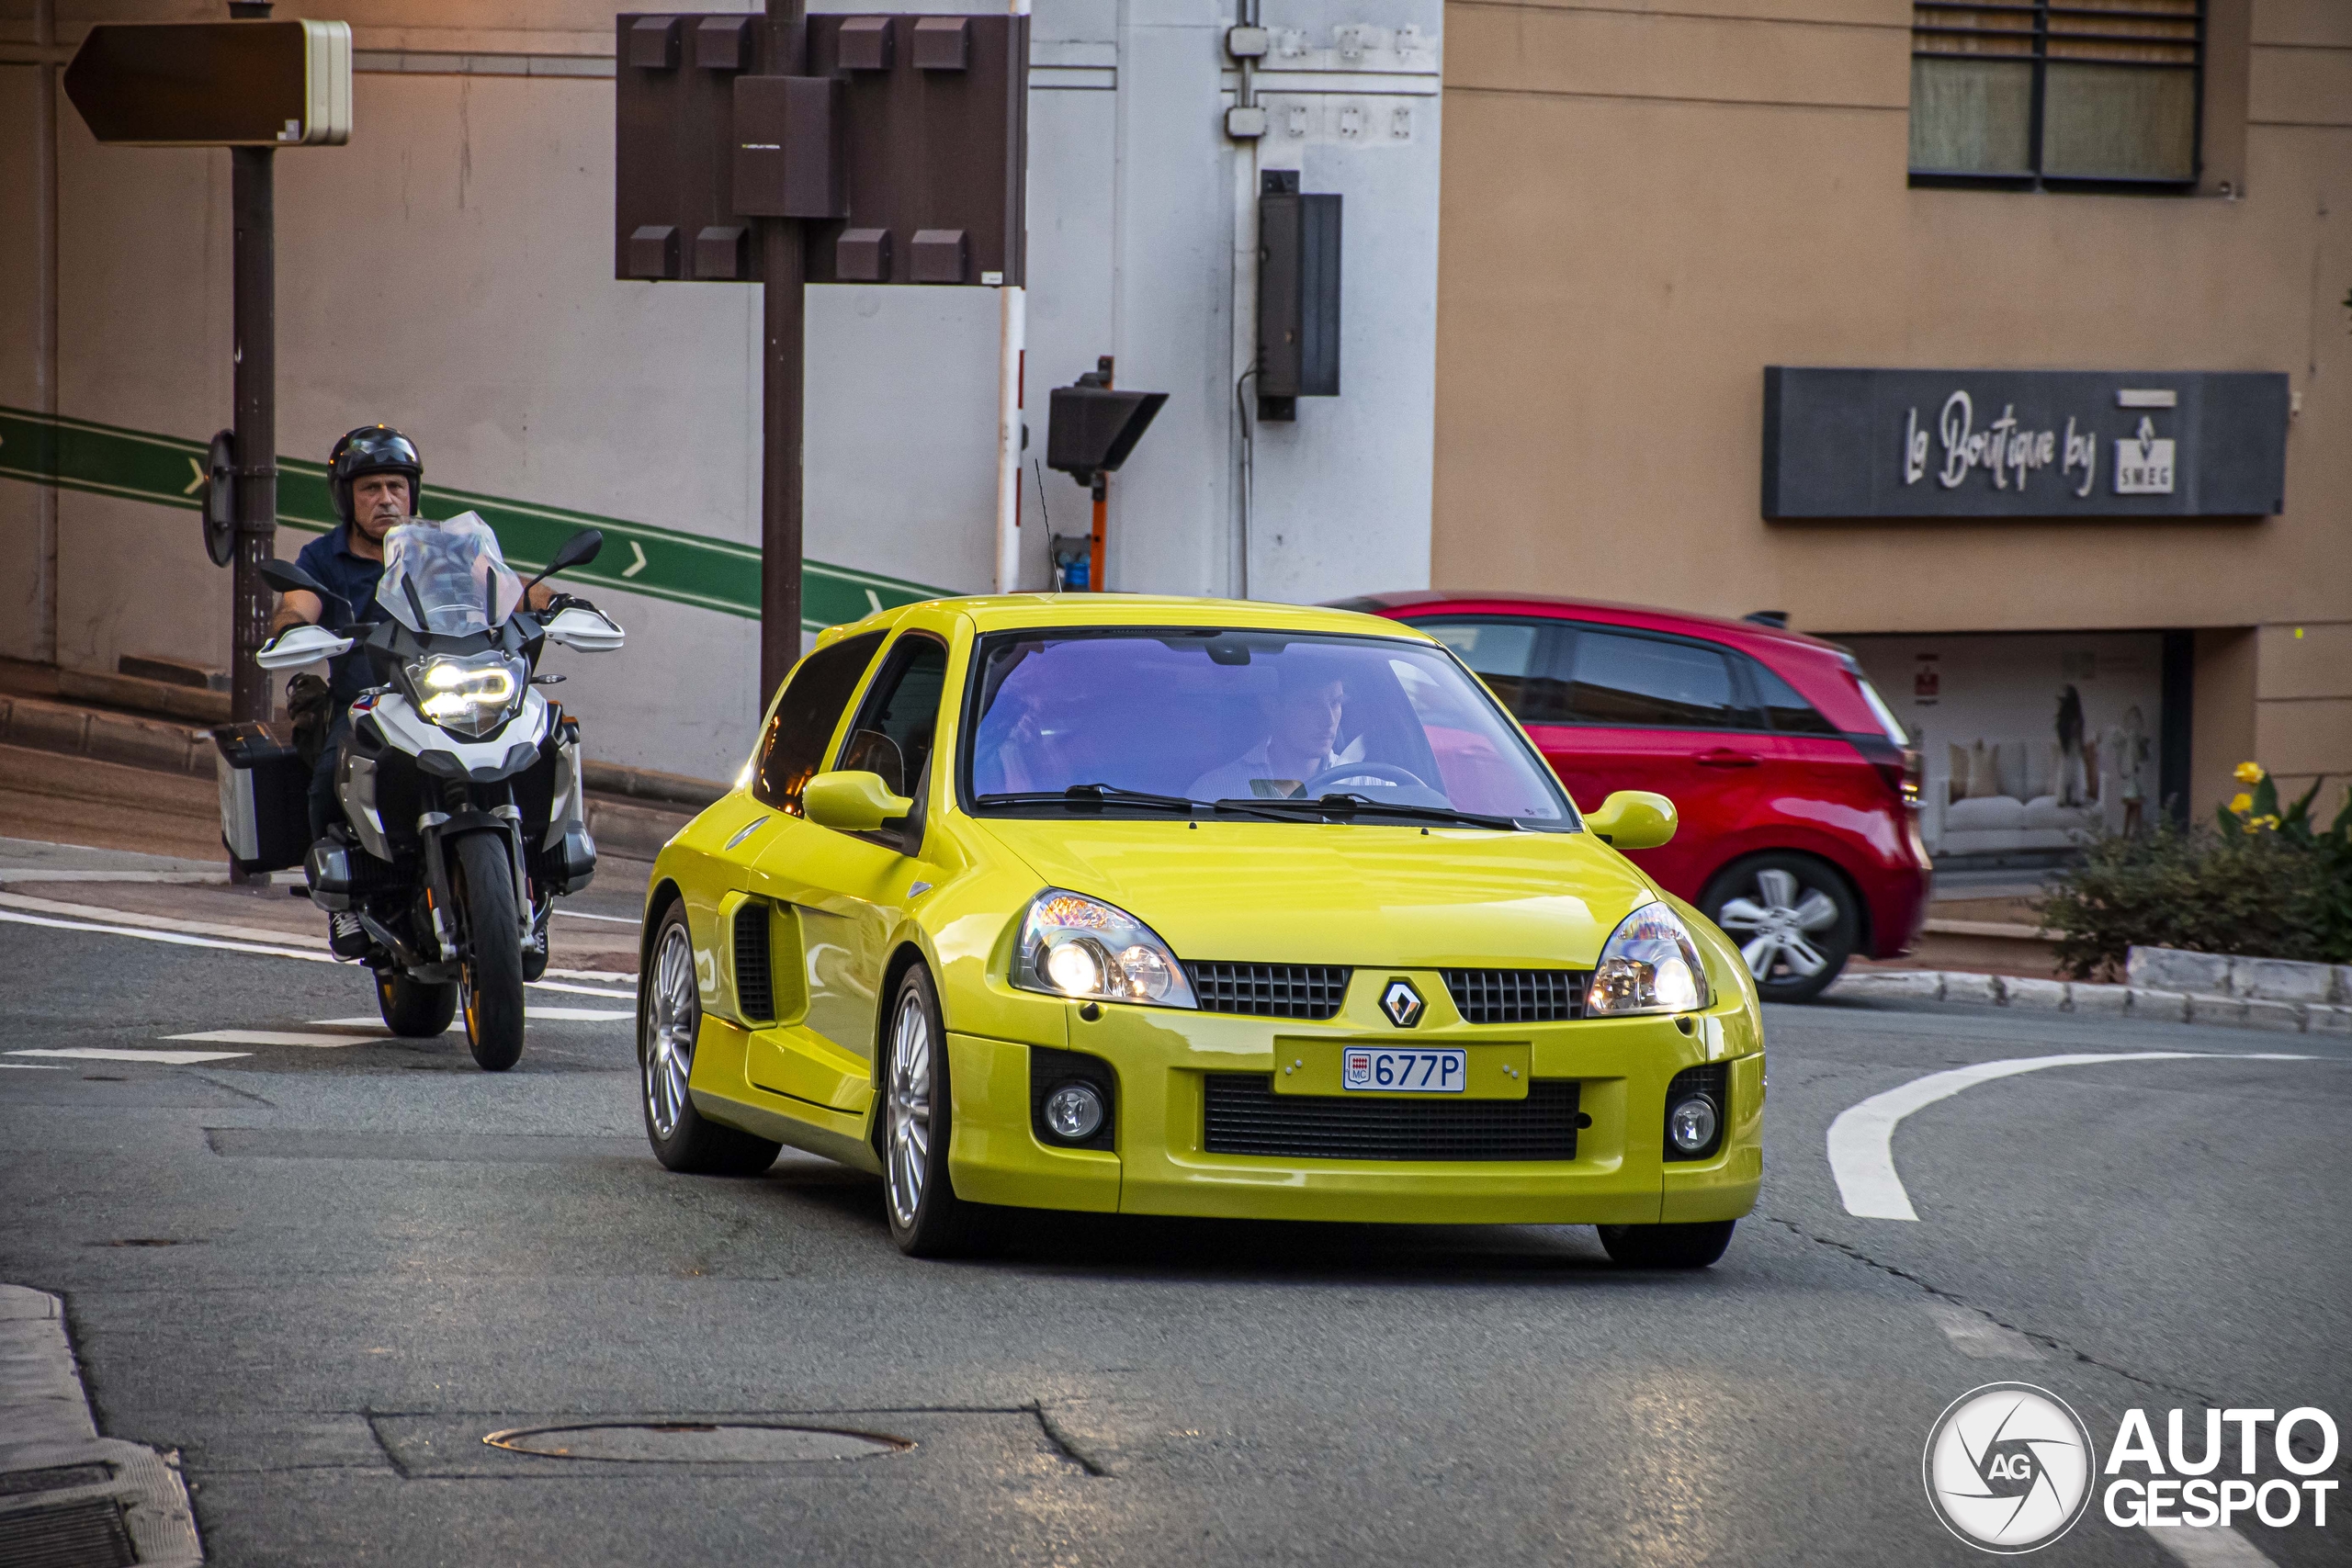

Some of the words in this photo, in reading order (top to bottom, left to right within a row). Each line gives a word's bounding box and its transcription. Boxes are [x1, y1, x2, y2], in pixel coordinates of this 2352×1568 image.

[1939, 389, 2055, 491] Boutique
[2063, 415, 2097, 497] by
[2120, 466, 2170, 487] SMEG
[1352, 1070, 1366, 1079] MC
[1375, 1055, 1459, 1086] 677P
